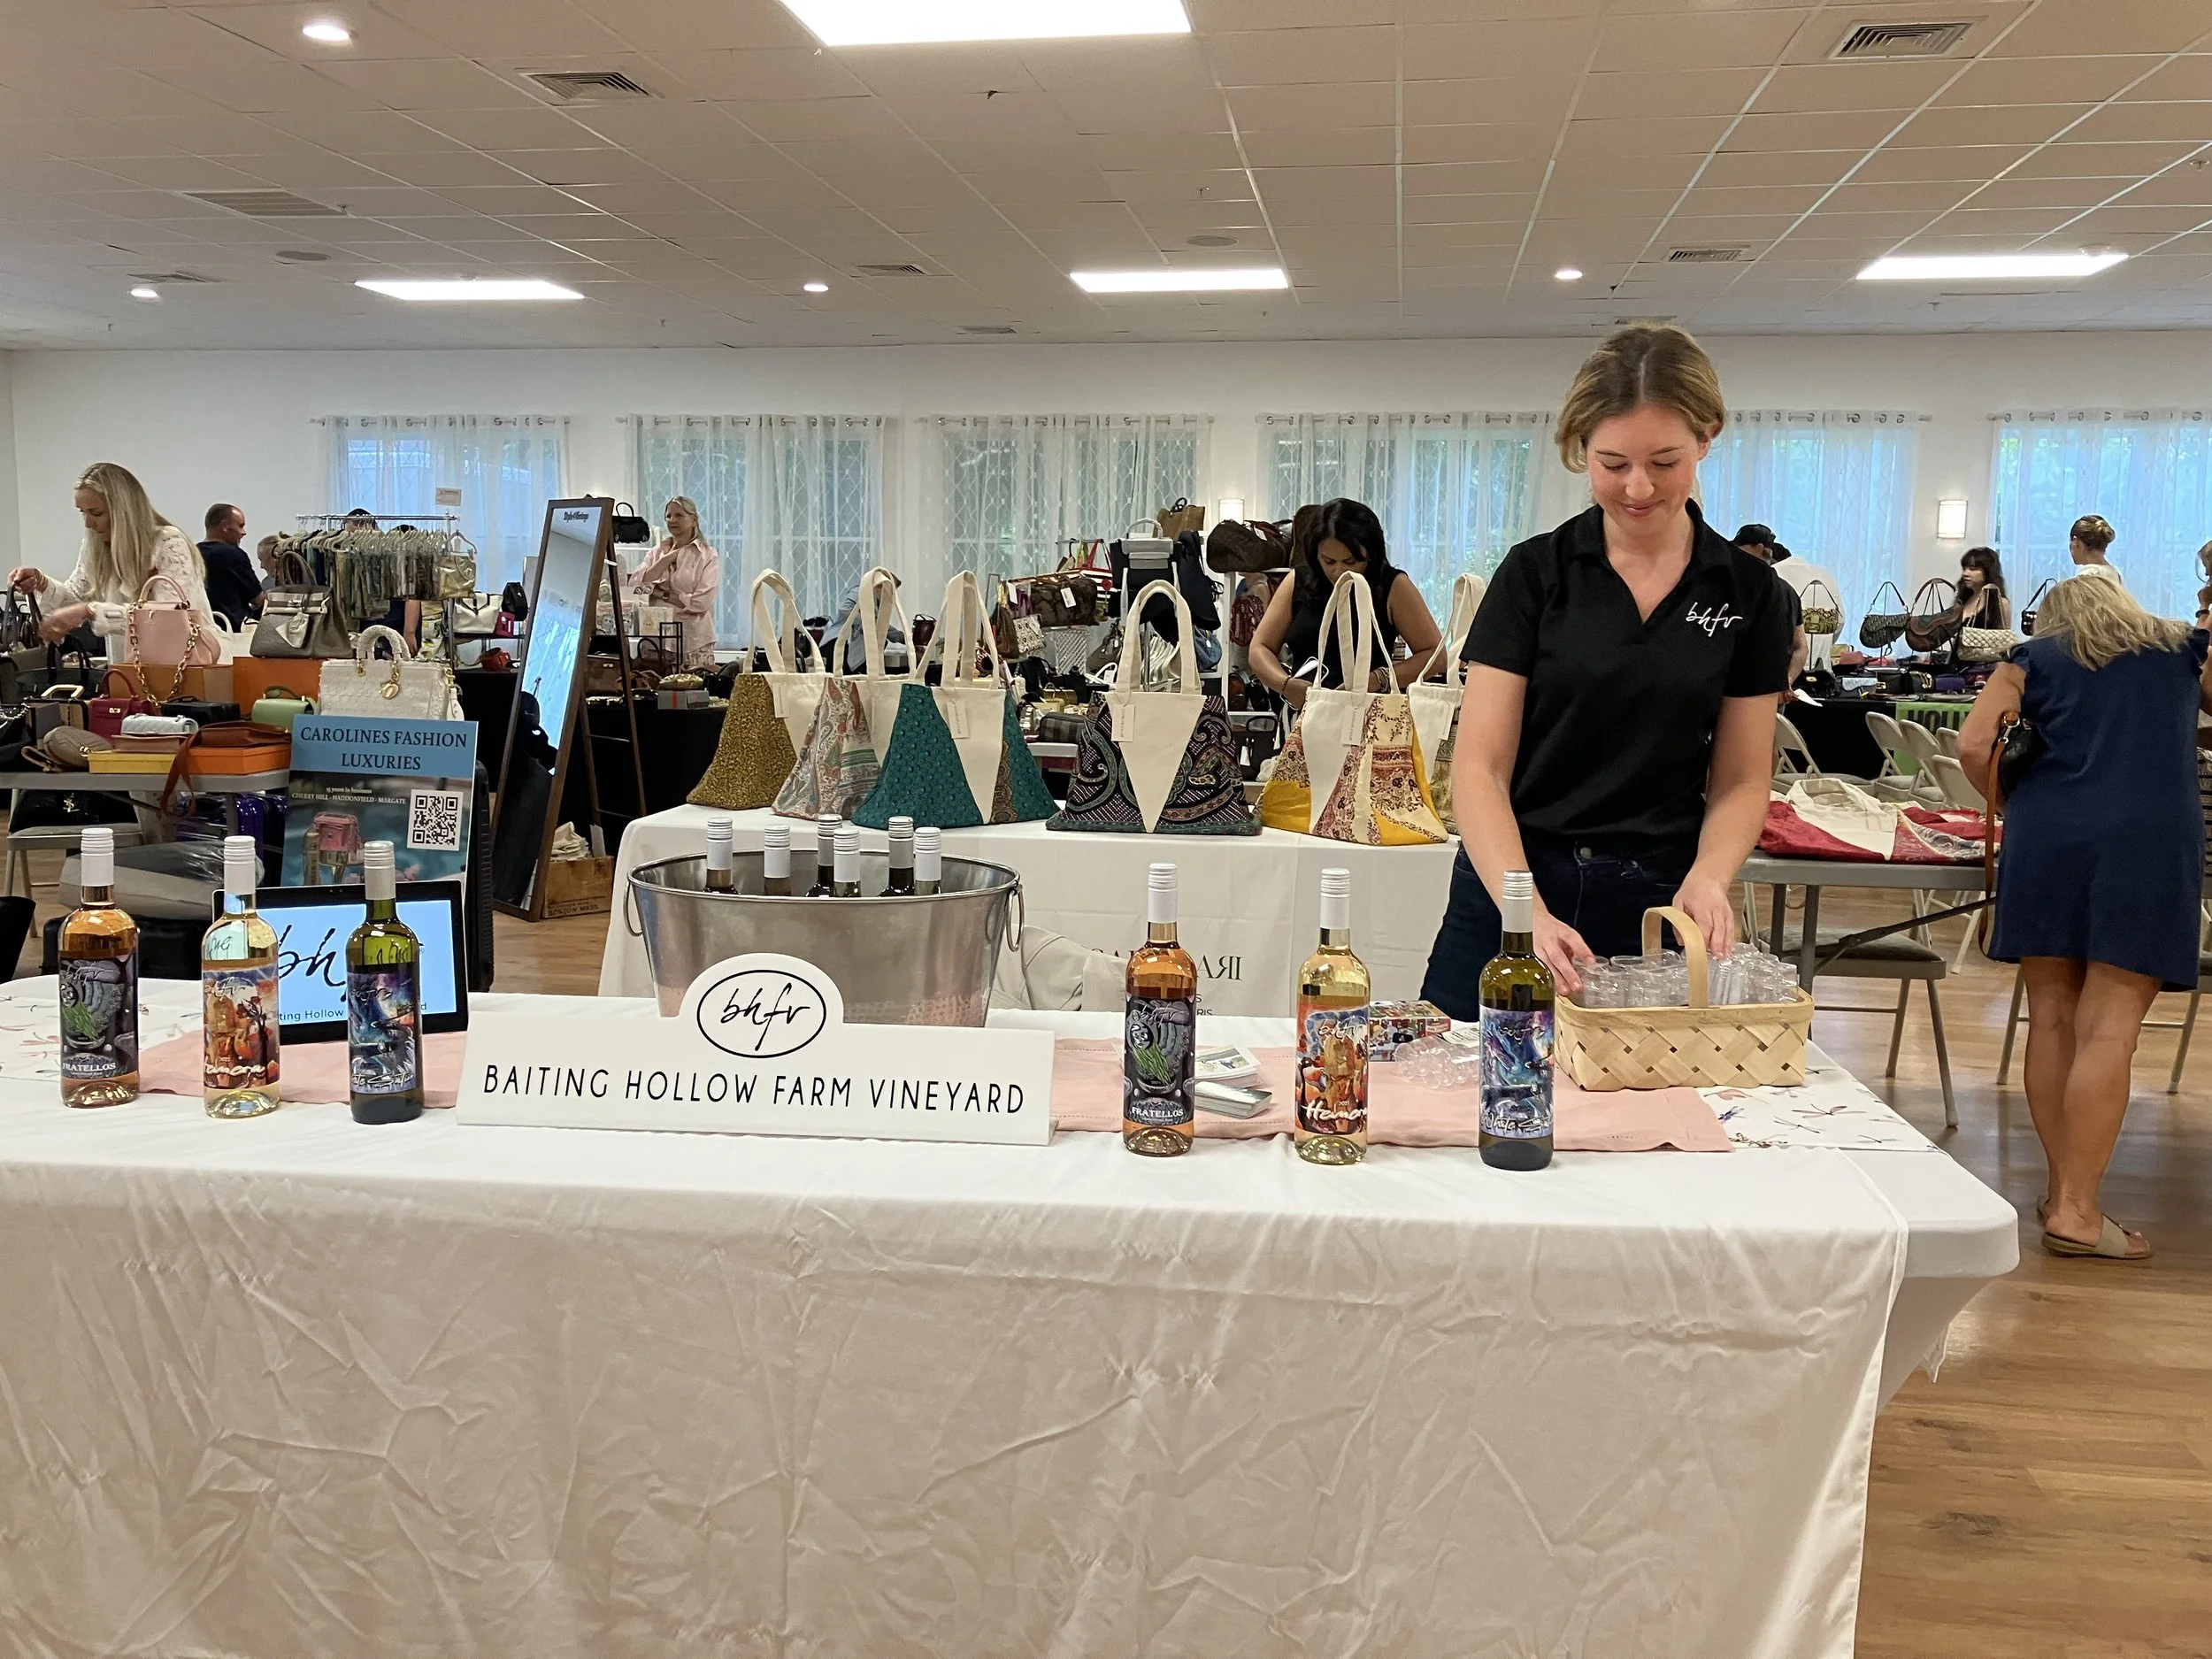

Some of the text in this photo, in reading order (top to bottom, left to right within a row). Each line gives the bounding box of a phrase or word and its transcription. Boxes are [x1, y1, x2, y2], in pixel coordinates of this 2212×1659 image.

[300, 726, 468, 748] CAROLINES FASHION
[341, 753, 421, 771] LUXURIES
[279, 1010, 344, 1022] ting Hollow
[483, 1064, 1026, 1115] BAITING HOLLOW FARM VINEYARD
[1131, 1106, 1184, 1118] FRATELLOS
